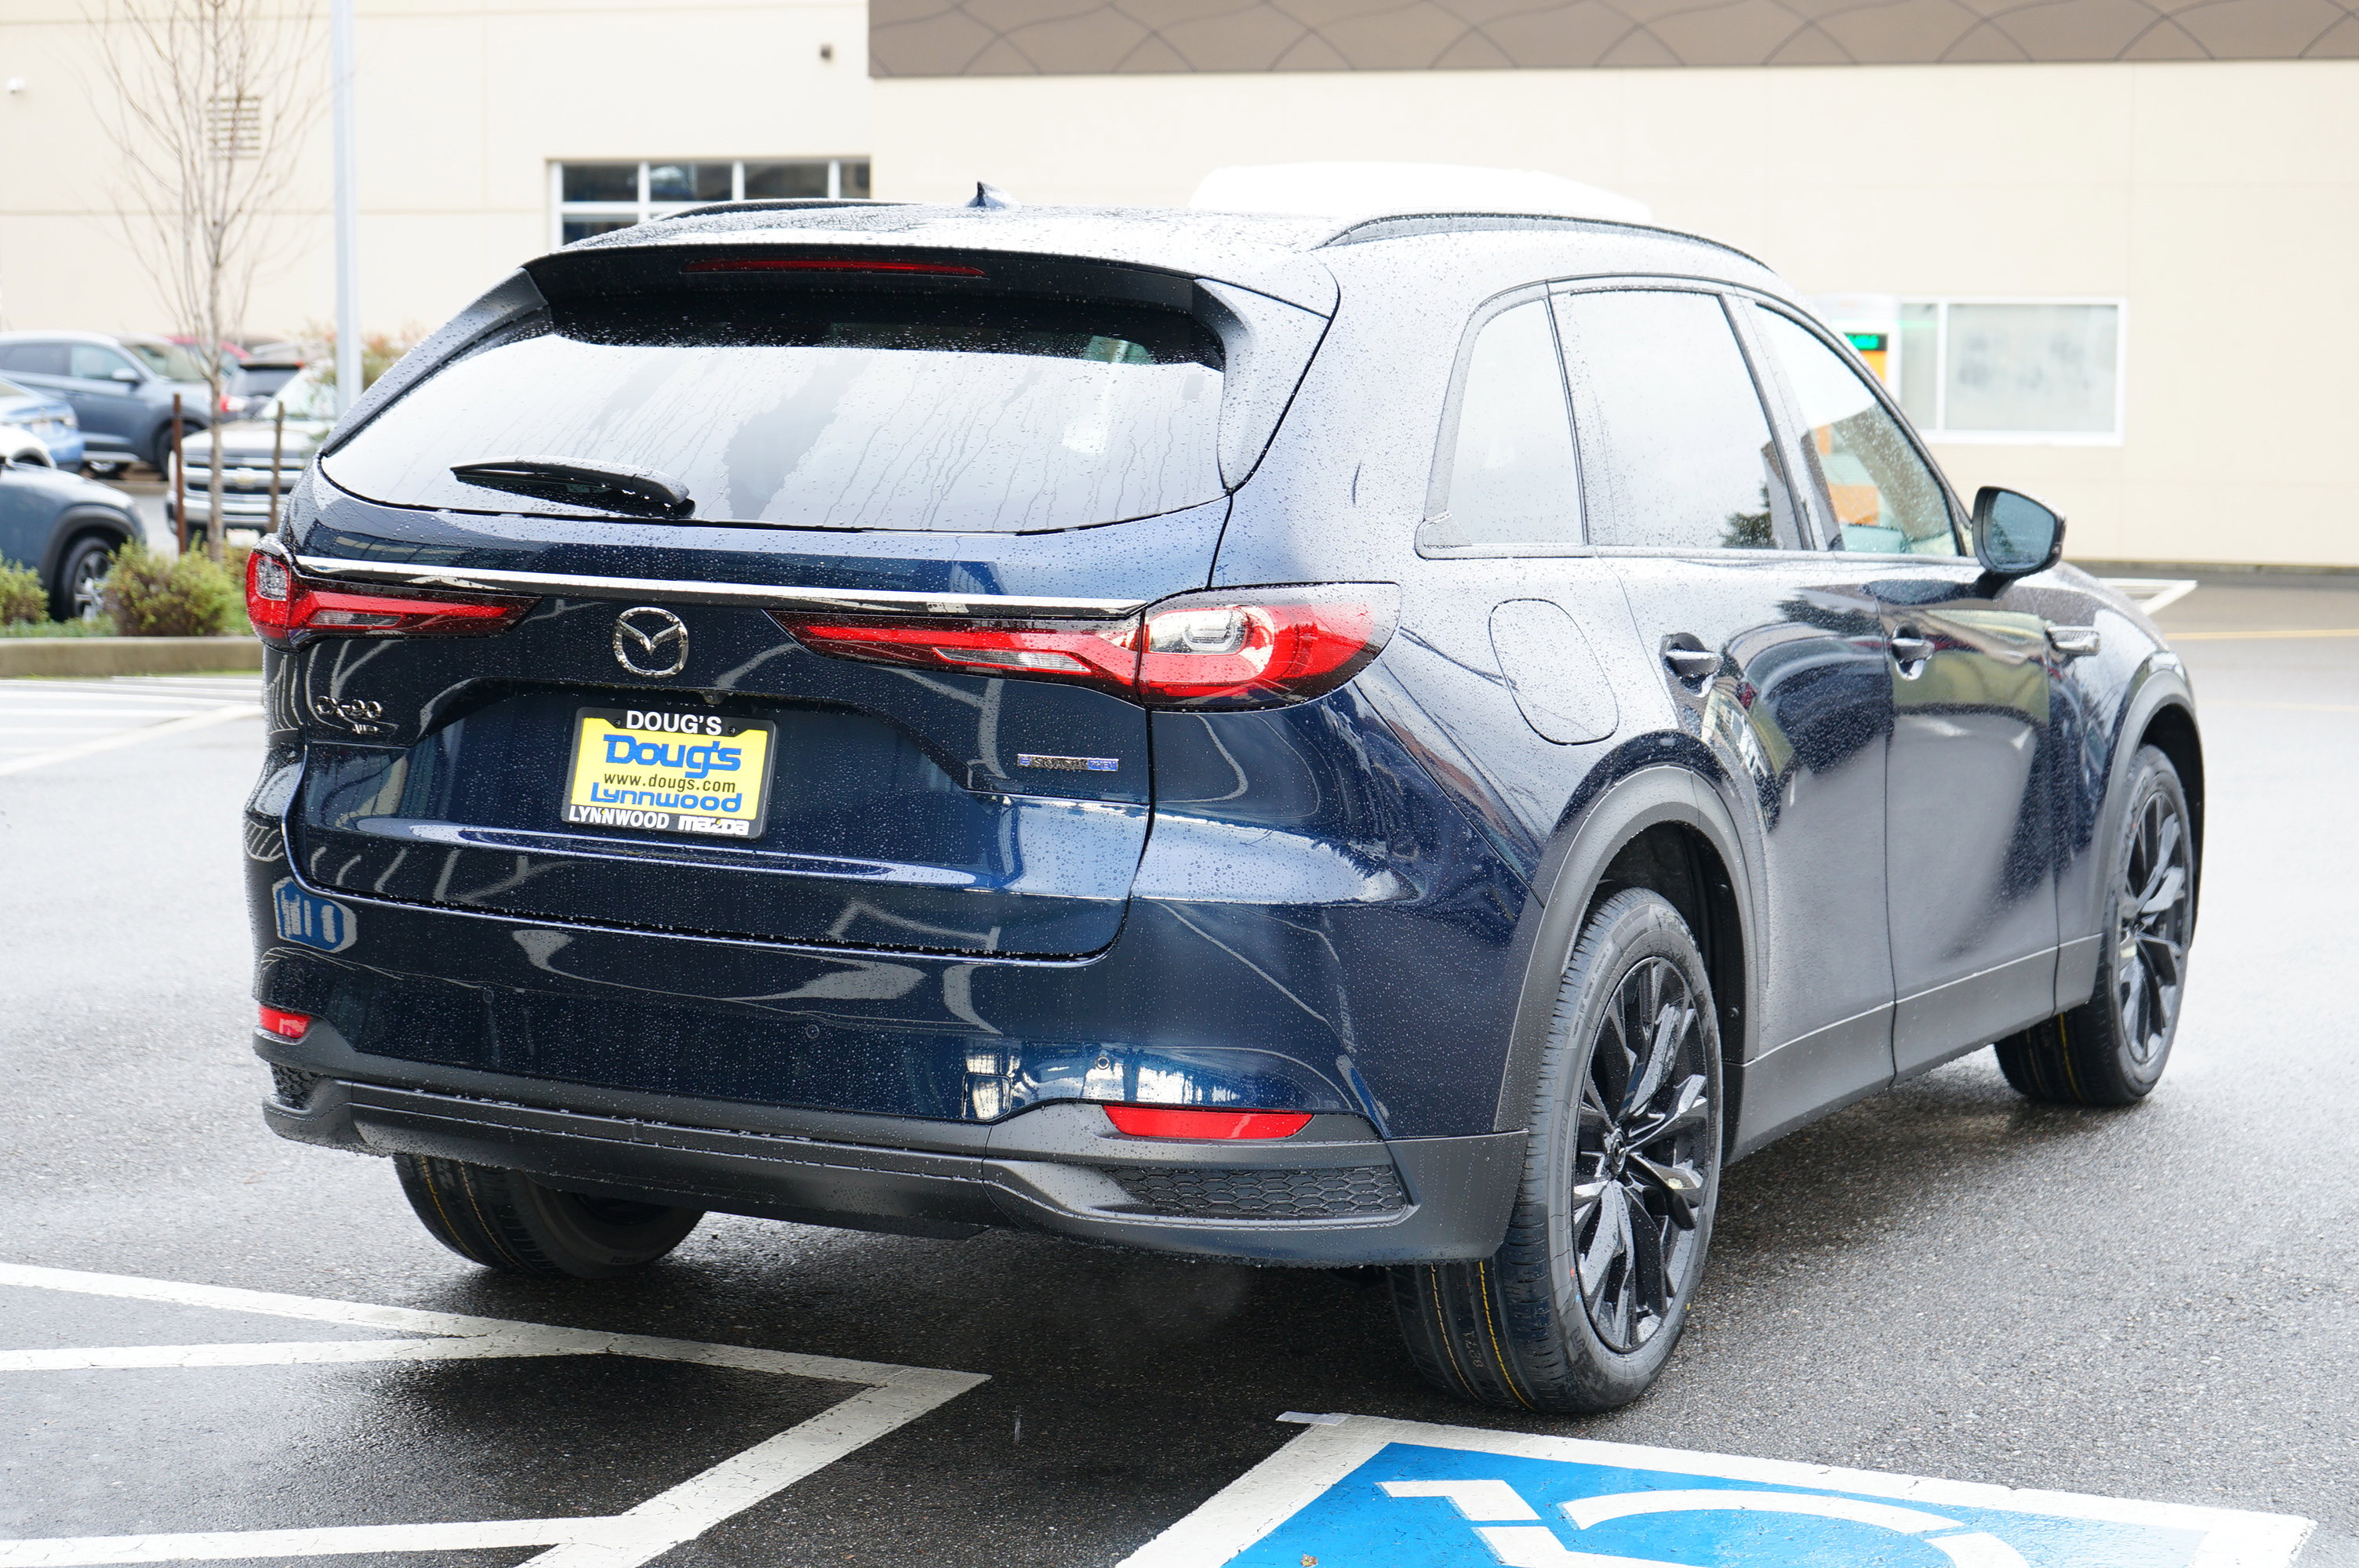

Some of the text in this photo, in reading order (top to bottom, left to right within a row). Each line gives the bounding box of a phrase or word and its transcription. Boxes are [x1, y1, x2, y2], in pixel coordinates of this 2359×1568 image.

[626, 710, 722, 735] DOUG'S
[603, 733, 742, 779] Doug's
[604, 773, 736, 793] www.dougs.com
[591, 782, 743, 813] Lynnwood
[569, 805, 670, 829] LYNNWOOD
